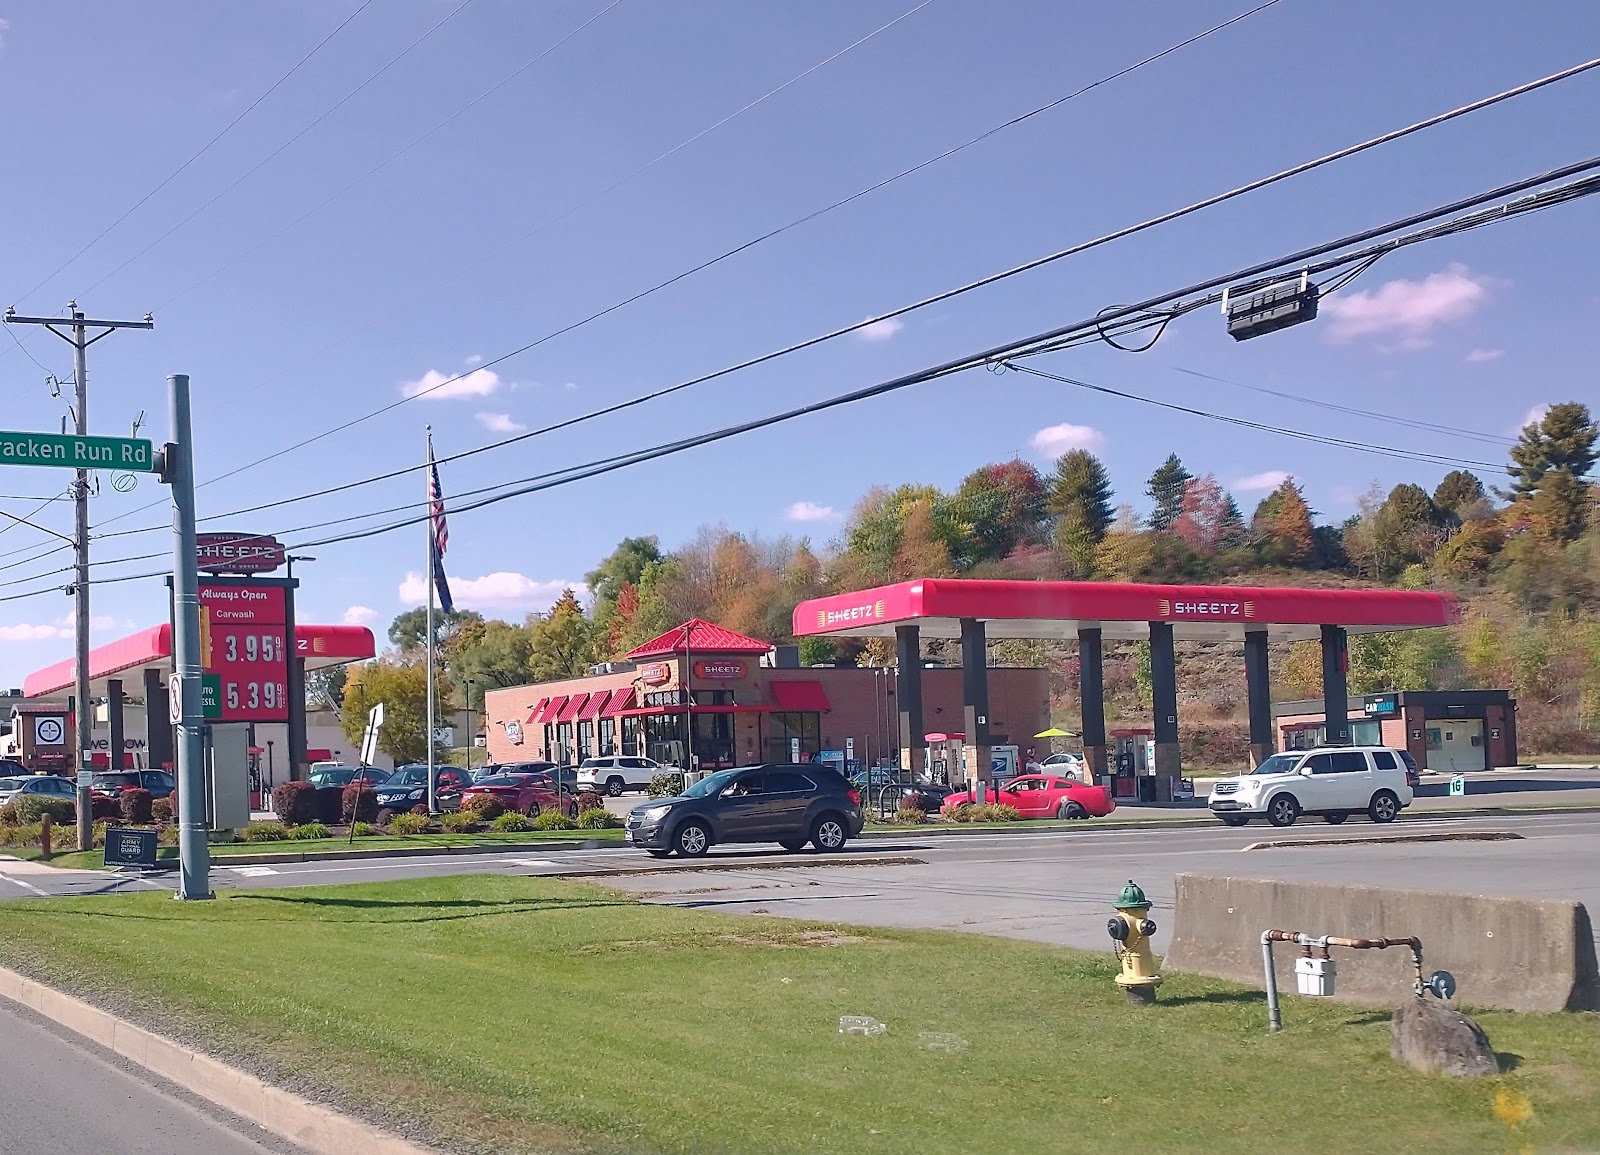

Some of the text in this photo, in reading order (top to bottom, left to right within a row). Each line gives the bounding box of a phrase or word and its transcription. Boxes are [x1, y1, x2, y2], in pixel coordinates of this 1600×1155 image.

[74, 442, 112, 460] Run
[121, 444, 146, 462] Rd
[201, 589, 267, 601] Always Open
[216, 610, 254, 618] Carwash
[827, 605, 873, 623] SHEETZ
[1175, 602, 1239, 614] SHEETZ
[225, 635, 274, 661] 3.95
[227, 682, 275, 709] 5.39
[1452, 780, 1461, 792] 16
